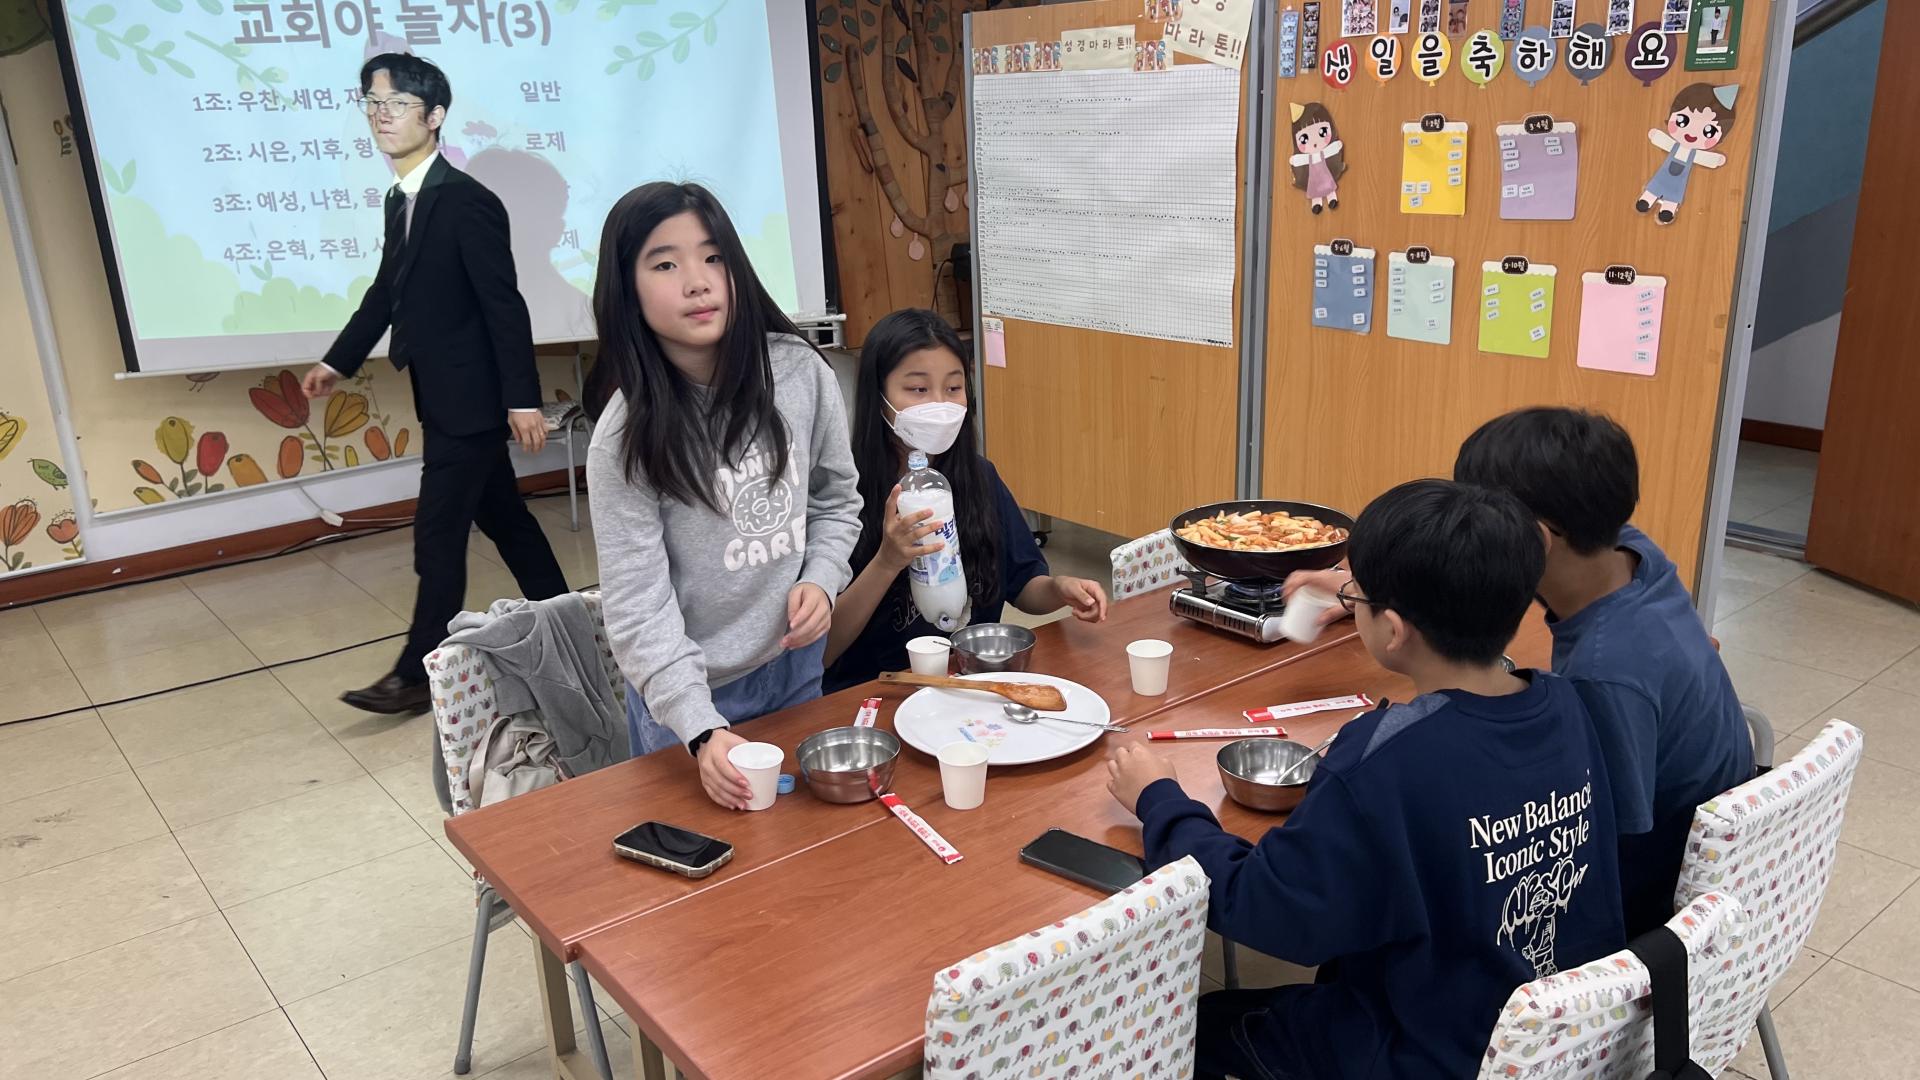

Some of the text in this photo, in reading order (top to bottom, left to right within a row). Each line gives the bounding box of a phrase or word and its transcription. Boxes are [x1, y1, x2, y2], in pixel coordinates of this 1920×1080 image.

[233, 0, 384, 48] 교회야
[192, 93, 233, 112] 1조:
[237, 89, 286, 113] 우찬,
[292, 87, 341, 111] 세연,
[520, 80, 562, 103] 일반
[202, 143, 242, 163] 2조:
[248, 140, 296, 163] 시은,
[301, 138, 349, 161] 지후,
[526, 131, 567, 152] 로제
[213, 193, 252, 213] 3조:
[256, 191, 306, 213] 예성,
[310, 189, 358, 210] 나현,
[223, 243, 262, 262] 4조:
[319, 238, 368, 260] 주원,
[1468, 815, 1521, 849] New
[1484, 814, 1589, 884] Iconic Style
